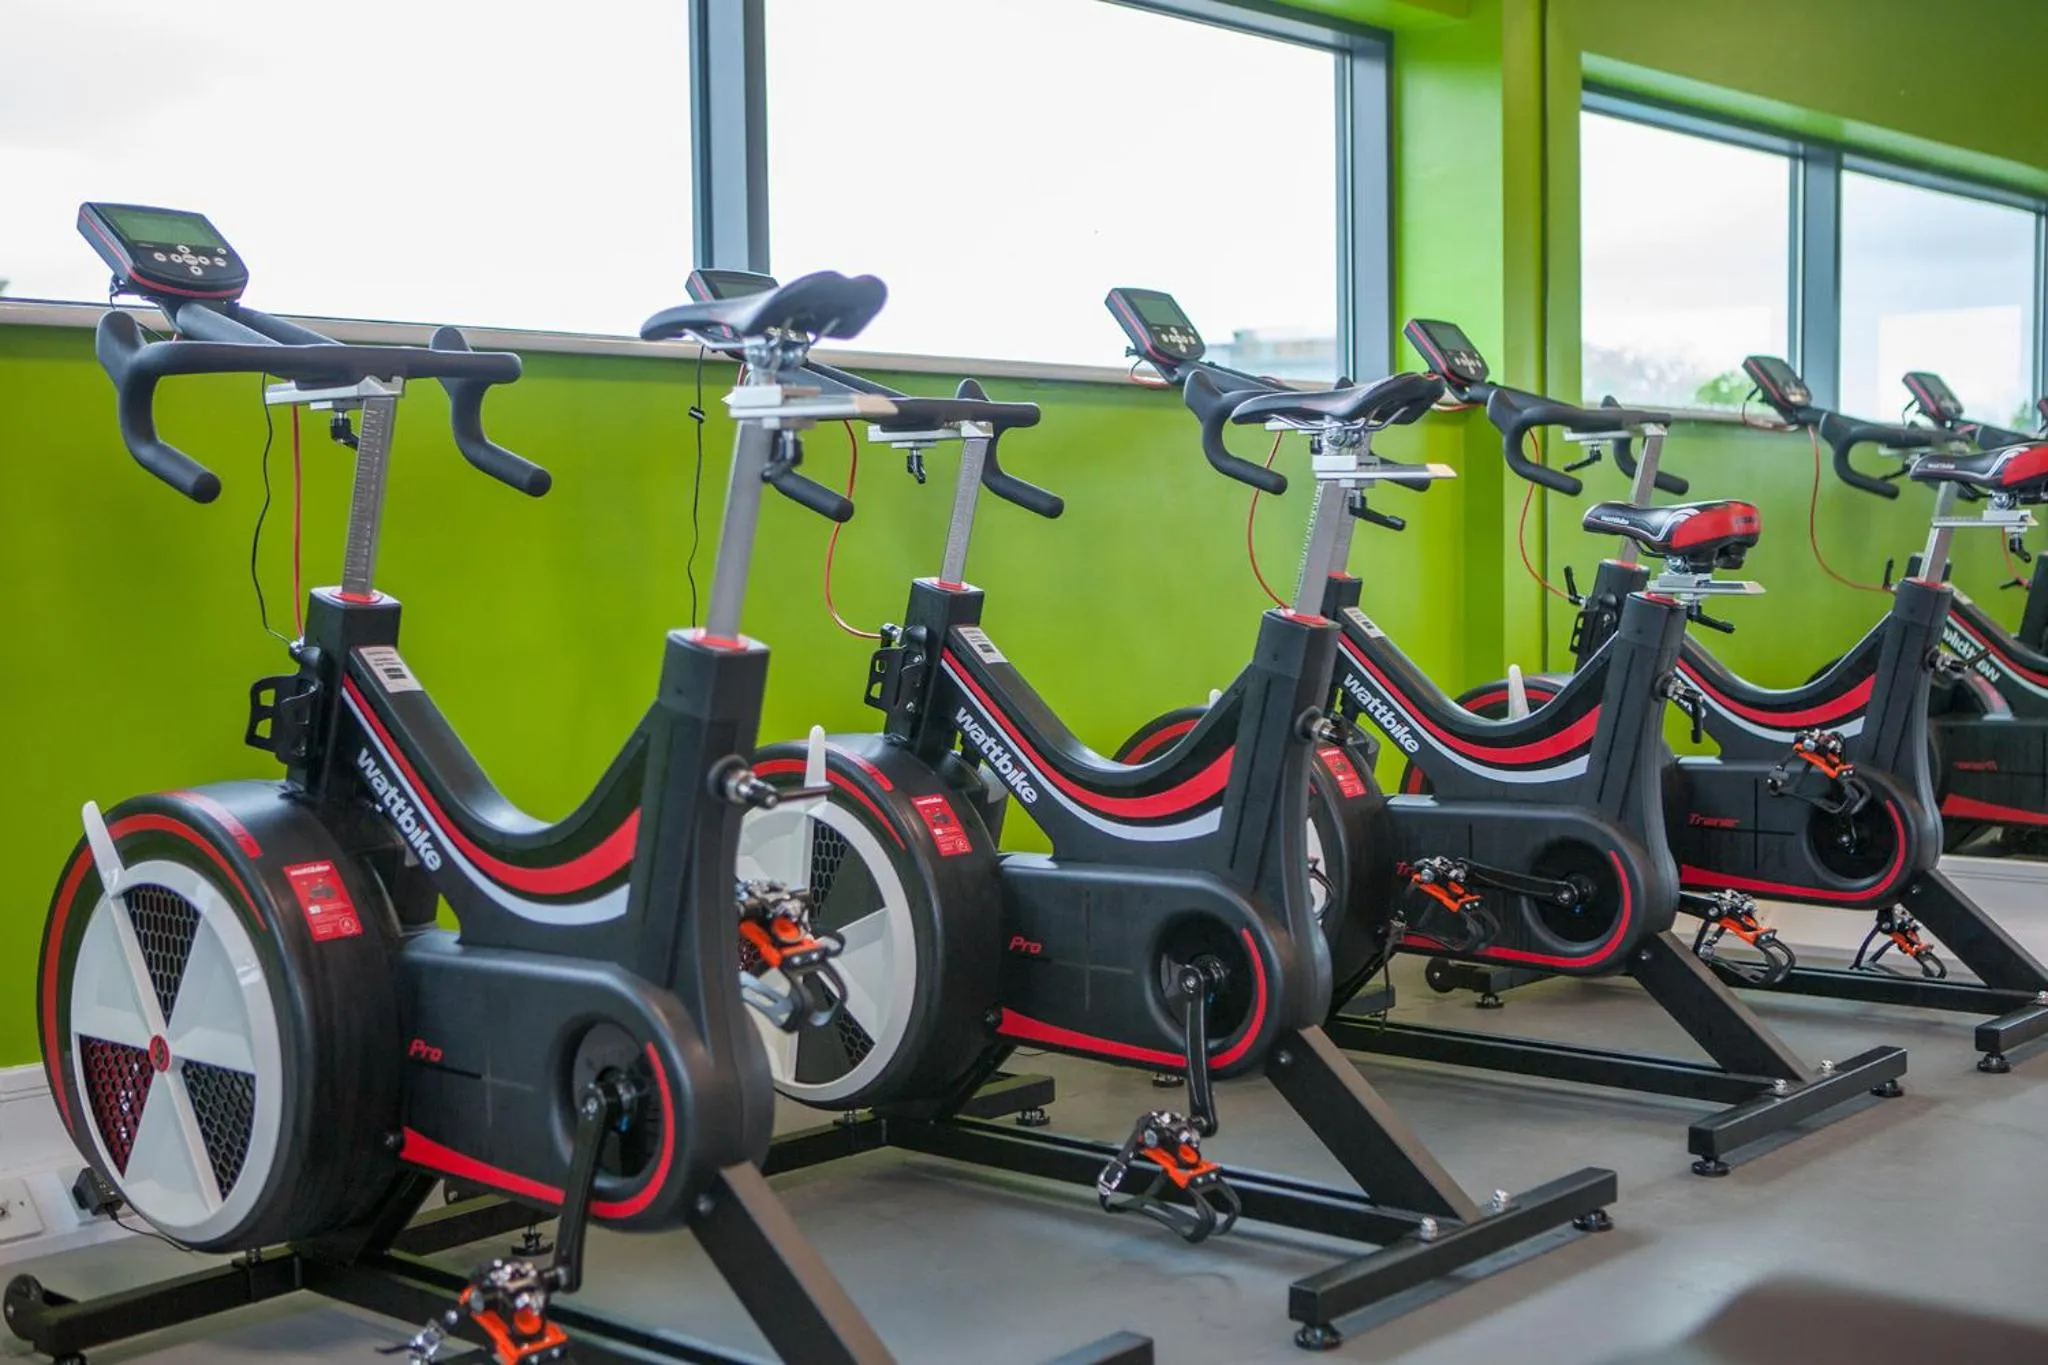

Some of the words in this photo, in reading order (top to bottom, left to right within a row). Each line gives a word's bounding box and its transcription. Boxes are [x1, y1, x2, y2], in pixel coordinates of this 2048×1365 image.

[1343, 673, 1420, 753] wattbike
[956, 707, 1038, 803] wattbike
[357, 747, 442, 871] wattbike
[1008, 936, 1042, 954] Pro
[408, 1038, 443, 1062] Pro
